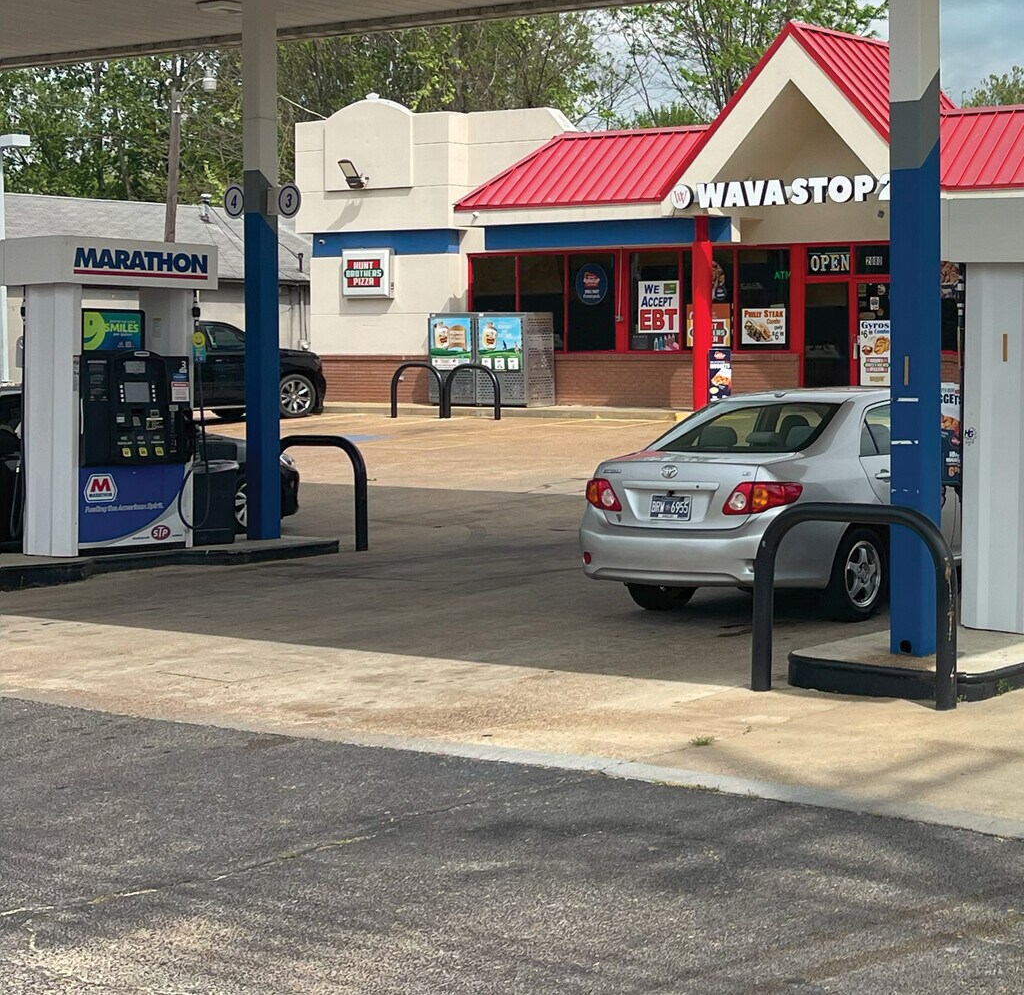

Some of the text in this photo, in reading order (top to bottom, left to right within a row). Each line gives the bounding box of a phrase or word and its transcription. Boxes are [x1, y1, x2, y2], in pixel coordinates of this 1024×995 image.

[697, 179, 785, 208] WAVA
[790, 174, 874, 205] STOP
[231, 194, 237, 208] 4
[286, 193, 292, 208] 3
[75, 247, 208, 274] MARATHON
[353, 261, 374, 269] HUNT
[810, 254, 850, 272] OPEN
[345, 269, 382, 277] BROTHERS
[353, 278, 374, 286] PIZZA
[644, 284, 660, 294] WE
[641, 296, 673, 307] ACCEPT
[640, 309, 677, 330] EBT
[764, 310, 784, 318] STEAK
[105, 323, 139, 333] SMILES
[861, 321, 890, 330] Gyros
[181, 361, 187, 369] 3
[90, 478, 111, 492] M
[153, 526, 169, 538] STP
